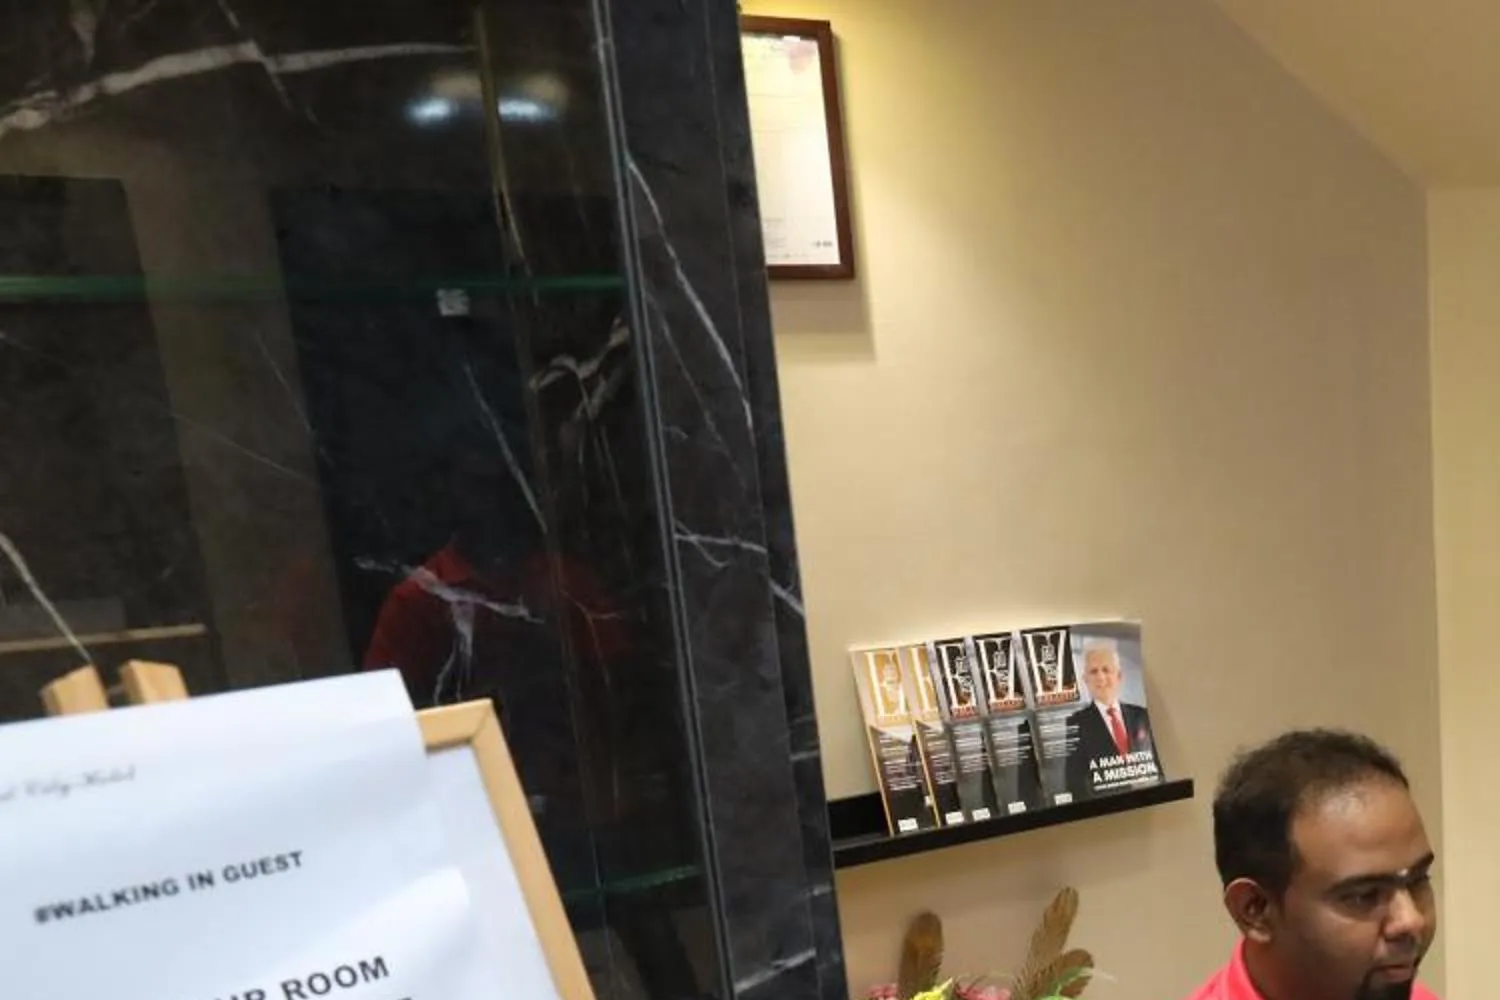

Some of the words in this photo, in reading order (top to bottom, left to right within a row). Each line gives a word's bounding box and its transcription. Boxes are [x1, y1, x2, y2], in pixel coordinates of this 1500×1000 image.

[1090, 759, 1098, 770] A
[1100, 754, 1125, 768] MAN
[1127, 751, 1153, 763] WITH
[1093, 771, 1102, 783] A
[1104, 762, 1157, 781] MISSION
[187, 873, 218, 891] IN
[223, 850, 303, 885] GUEST
